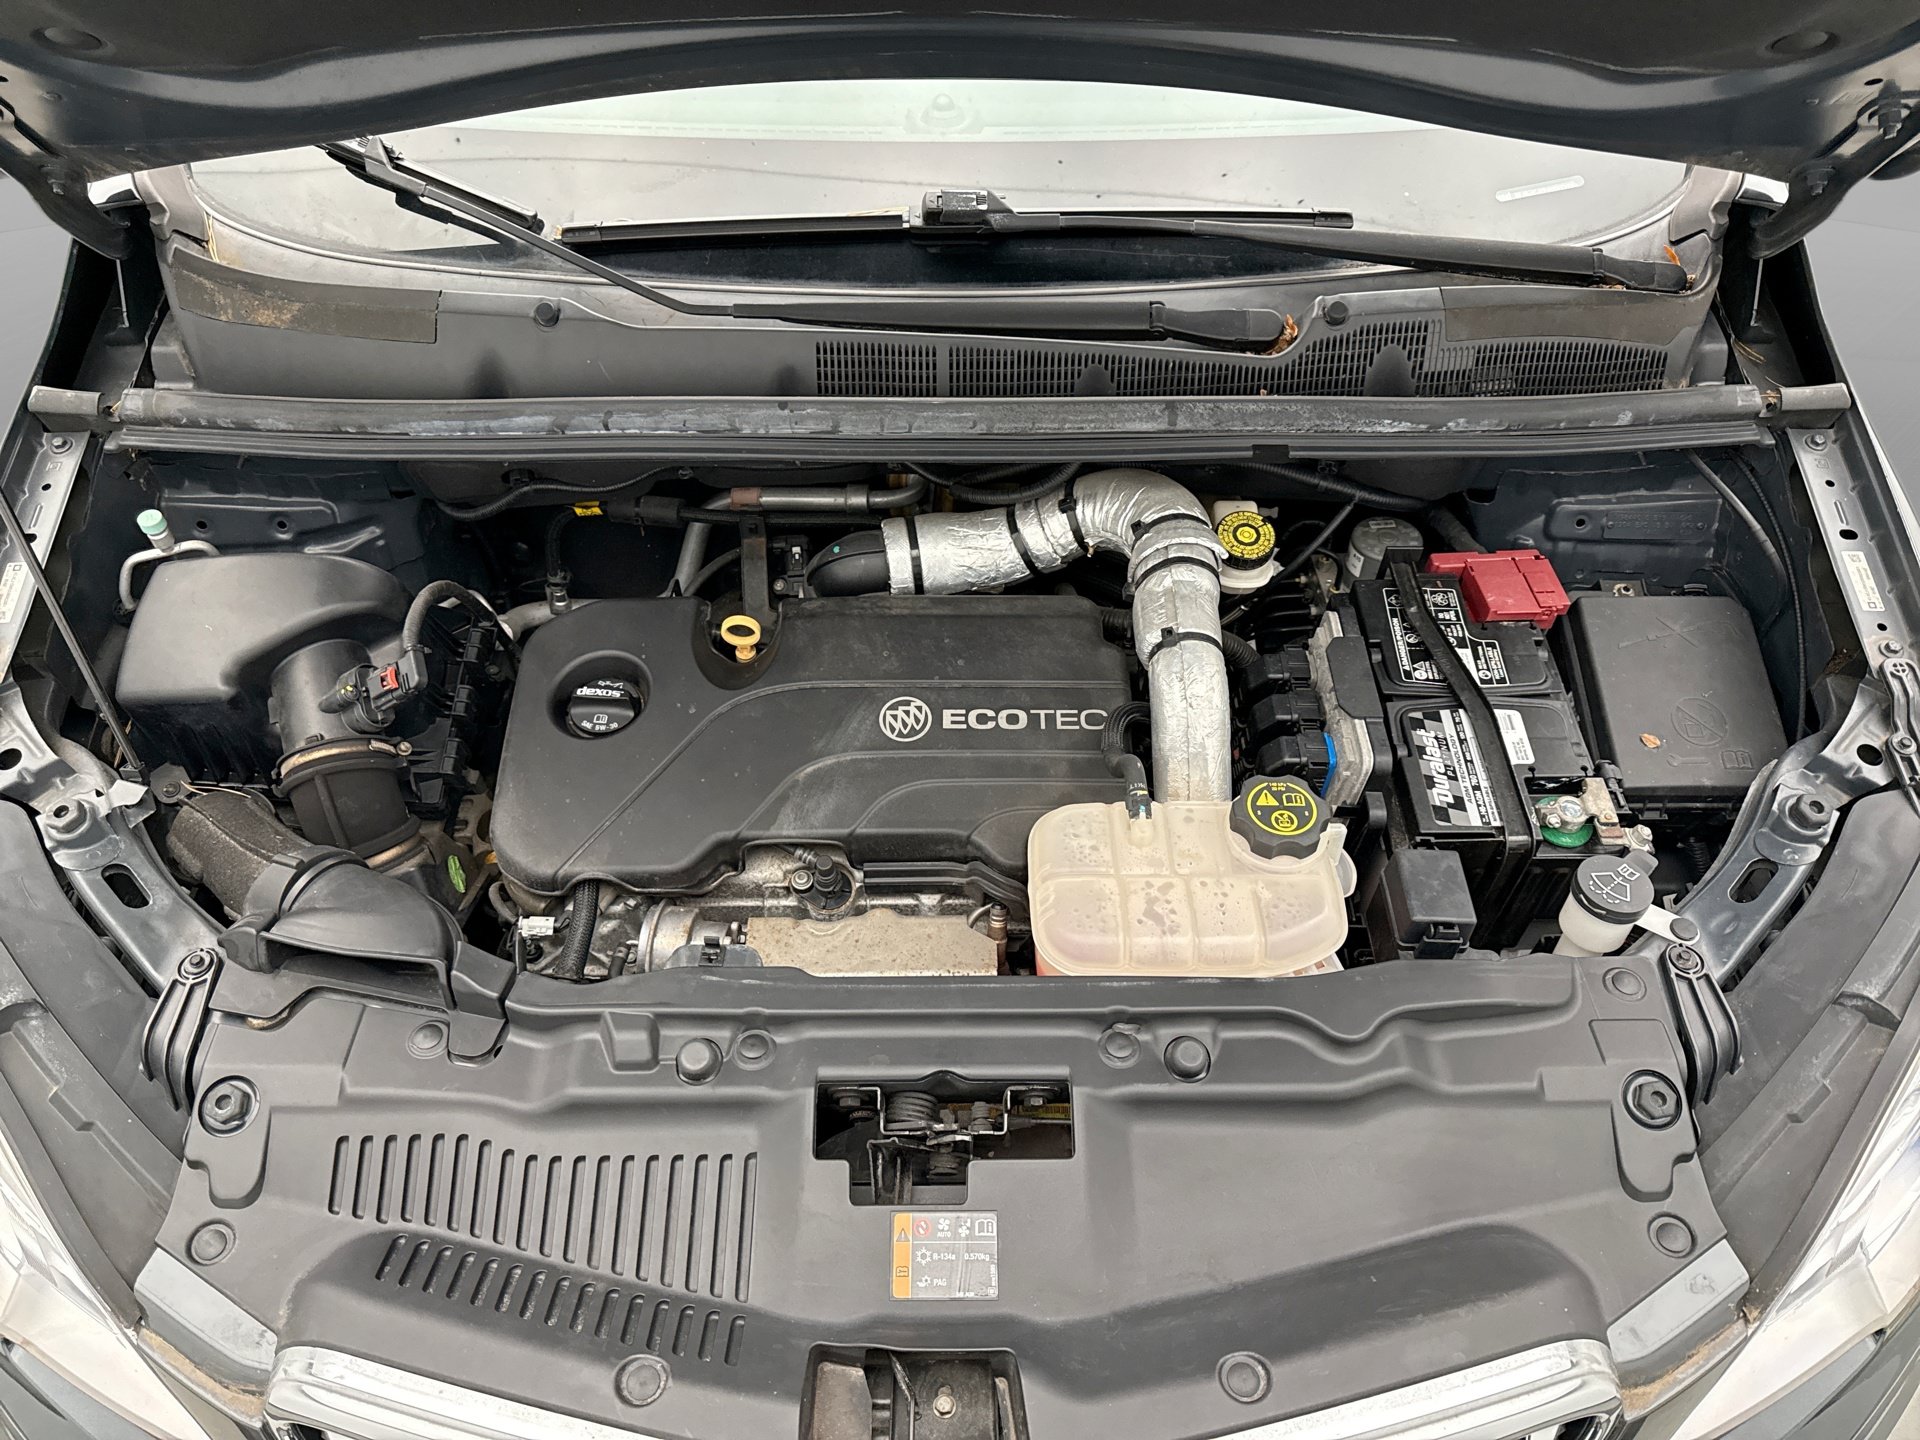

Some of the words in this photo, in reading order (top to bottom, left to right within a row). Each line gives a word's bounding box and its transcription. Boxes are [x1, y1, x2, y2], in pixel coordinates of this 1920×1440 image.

[577, 687, 621, 698] dexos
[581, 720, 593, 730] SAE
[595, 722, 618, 731] 5W-30
[942, 708, 1108, 730] ECOTEC
[1436, 731, 1456, 777] PLATINUM
[1447, 733, 1468, 784] TECHNOLOGY
[1416, 728, 1455, 806] Duralast
[1463, 783, 1474, 804] AGM
[933, 1252, 956, 1260] R-134a
[964, 1252, 990, 1262] 0.570kg
[933, 1278, 947, 1286] PAG
